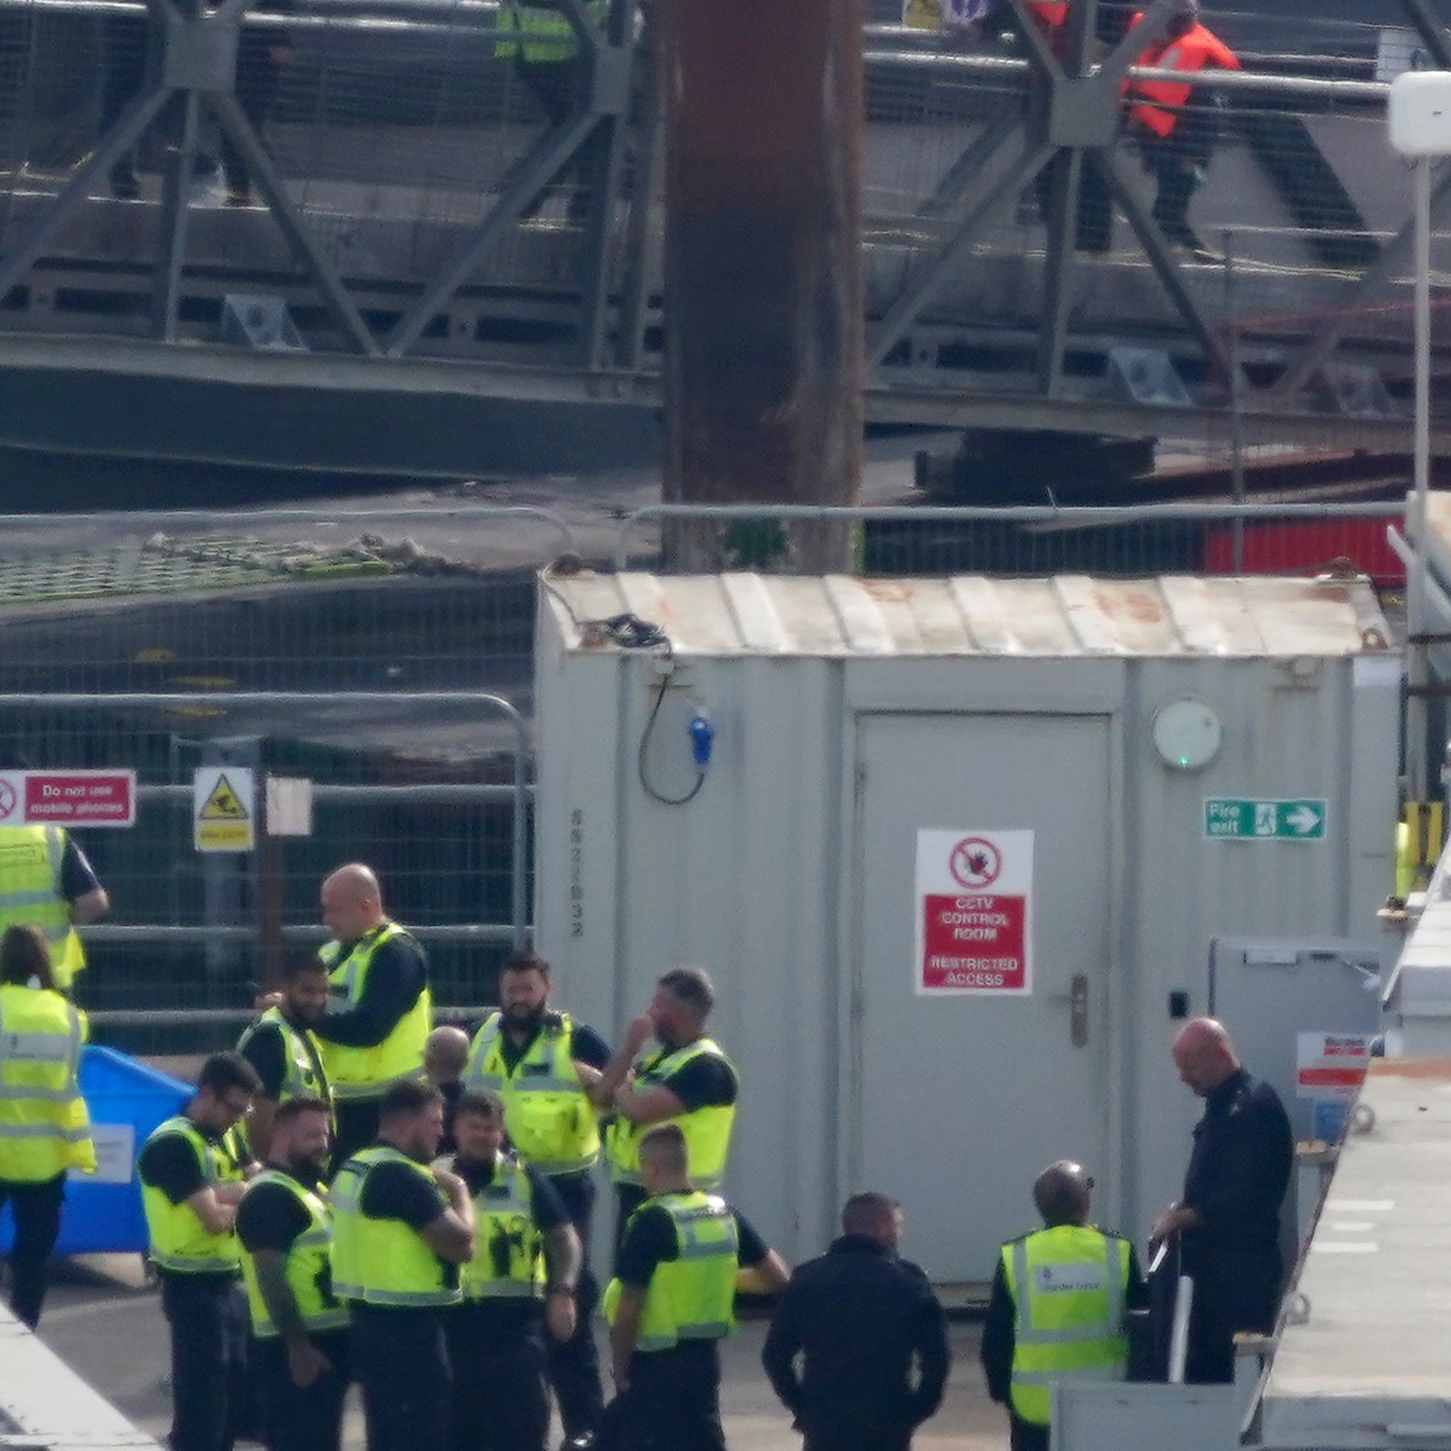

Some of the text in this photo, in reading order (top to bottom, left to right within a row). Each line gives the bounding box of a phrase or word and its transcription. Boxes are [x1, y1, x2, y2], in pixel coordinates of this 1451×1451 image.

[43, 784, 61, 797] Do
[65, 786, 85, 797] not
[31, 801, 74, 814] mobile
[1209, 803, 1240, 819] Fire
[1209, 820, 1239, 834] exit
[956, 897, 994, 909] CCTV
[942, 911, 1008, 926] CONTROL
[955, 928, 998, 940] ROOM
[932, 956, 1018, 970] RESTRICTED
[947, 972, 1004, 986] ACCESS
